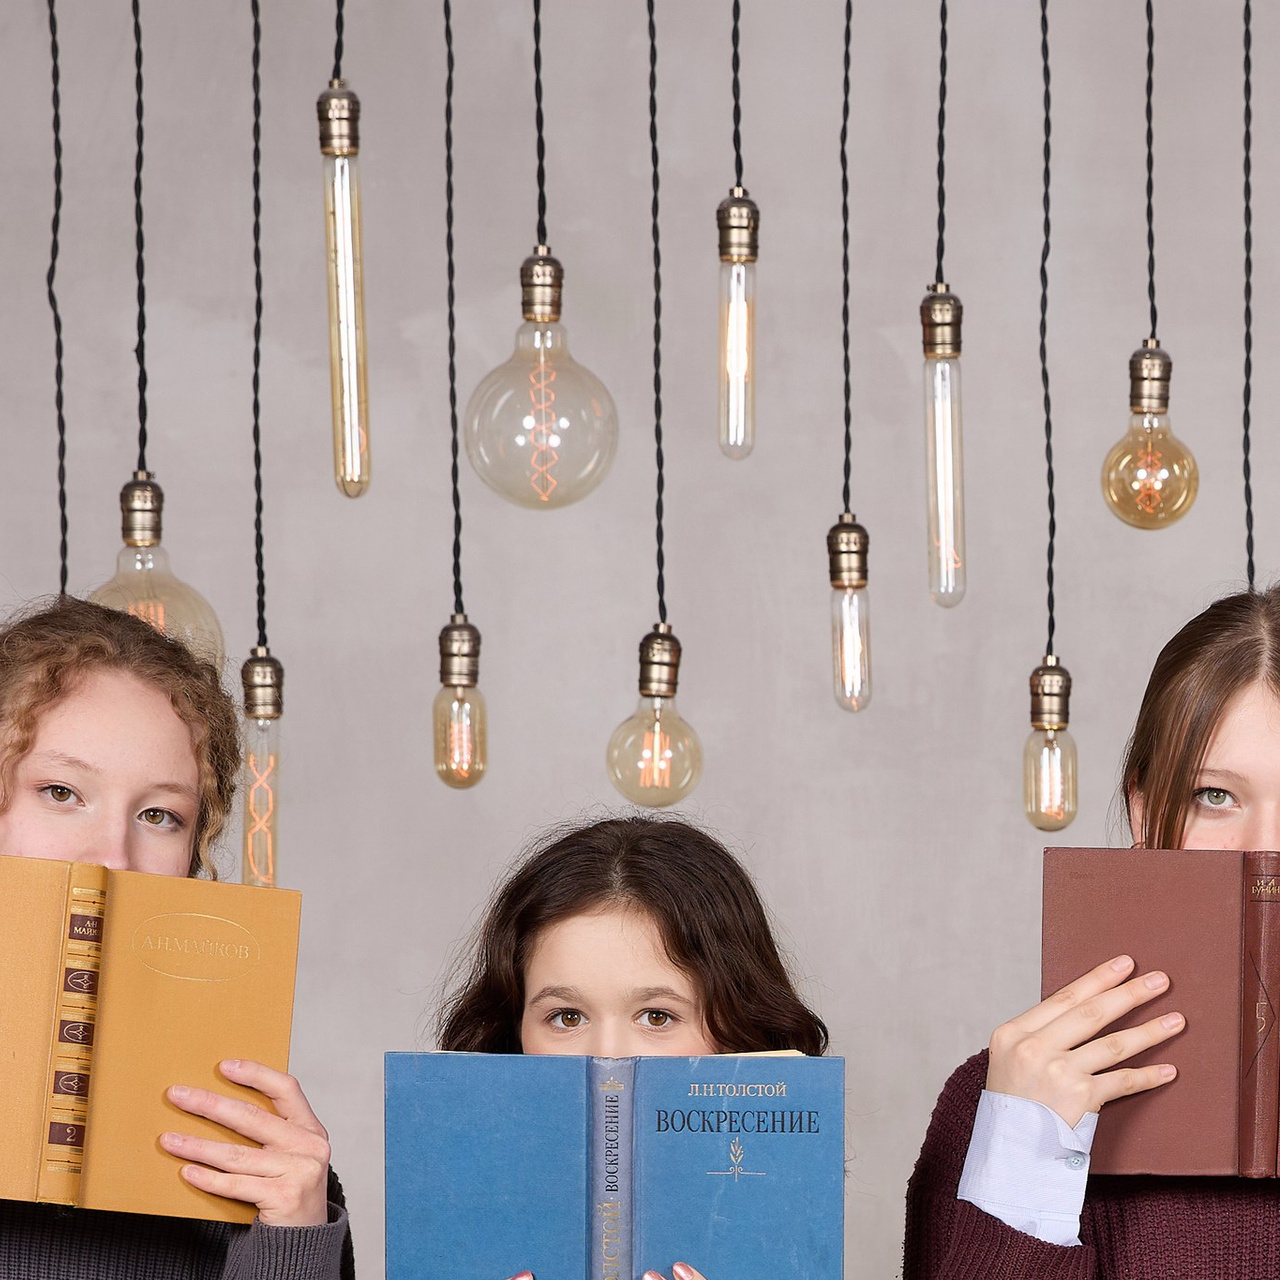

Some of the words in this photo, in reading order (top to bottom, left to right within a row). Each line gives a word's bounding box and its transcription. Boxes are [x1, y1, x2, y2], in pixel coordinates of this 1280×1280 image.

[1251, 885, 1280, 898] БУНИН
[1256, 1002, 1267, 1034] 5
[66, 1126, 77, 1142] 2
[655, 1109, 820, 1134] ВОСКРЕСЕНИЕ
[604, 1094, 620, 1193] ВОСКРЕСЕНИЕ
